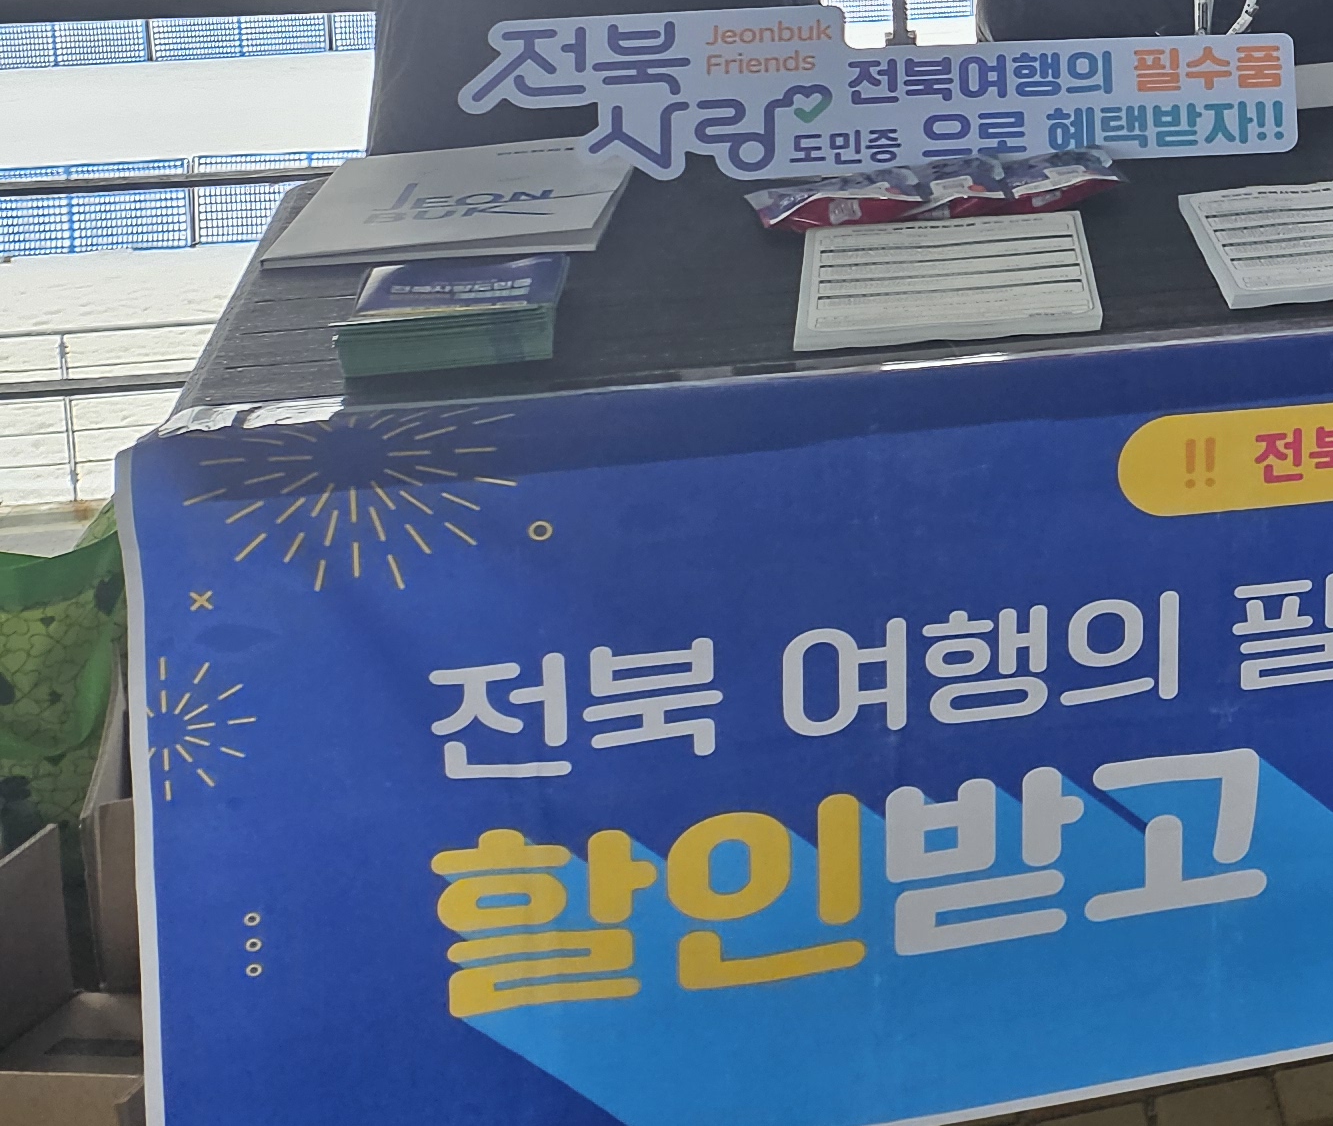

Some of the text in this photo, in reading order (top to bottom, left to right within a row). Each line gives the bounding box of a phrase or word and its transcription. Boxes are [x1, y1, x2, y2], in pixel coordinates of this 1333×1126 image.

[470, 21, 692, 103] 전북
[706, 20, 833, 47] Jeonbuk
[706, 50, 818, 76] Friends
[847, 46, 1283, 107] 전북여행의 필수품
[588, 96, 786, 172] 사랑
[788, 99, 1285, 166] 도민증 으로 혜택받자!!
[426, 637, 726, 781] 전북
[780, 591, 1181, 738] 여행의
[428, 747, 1268, 1019] 할인받고
